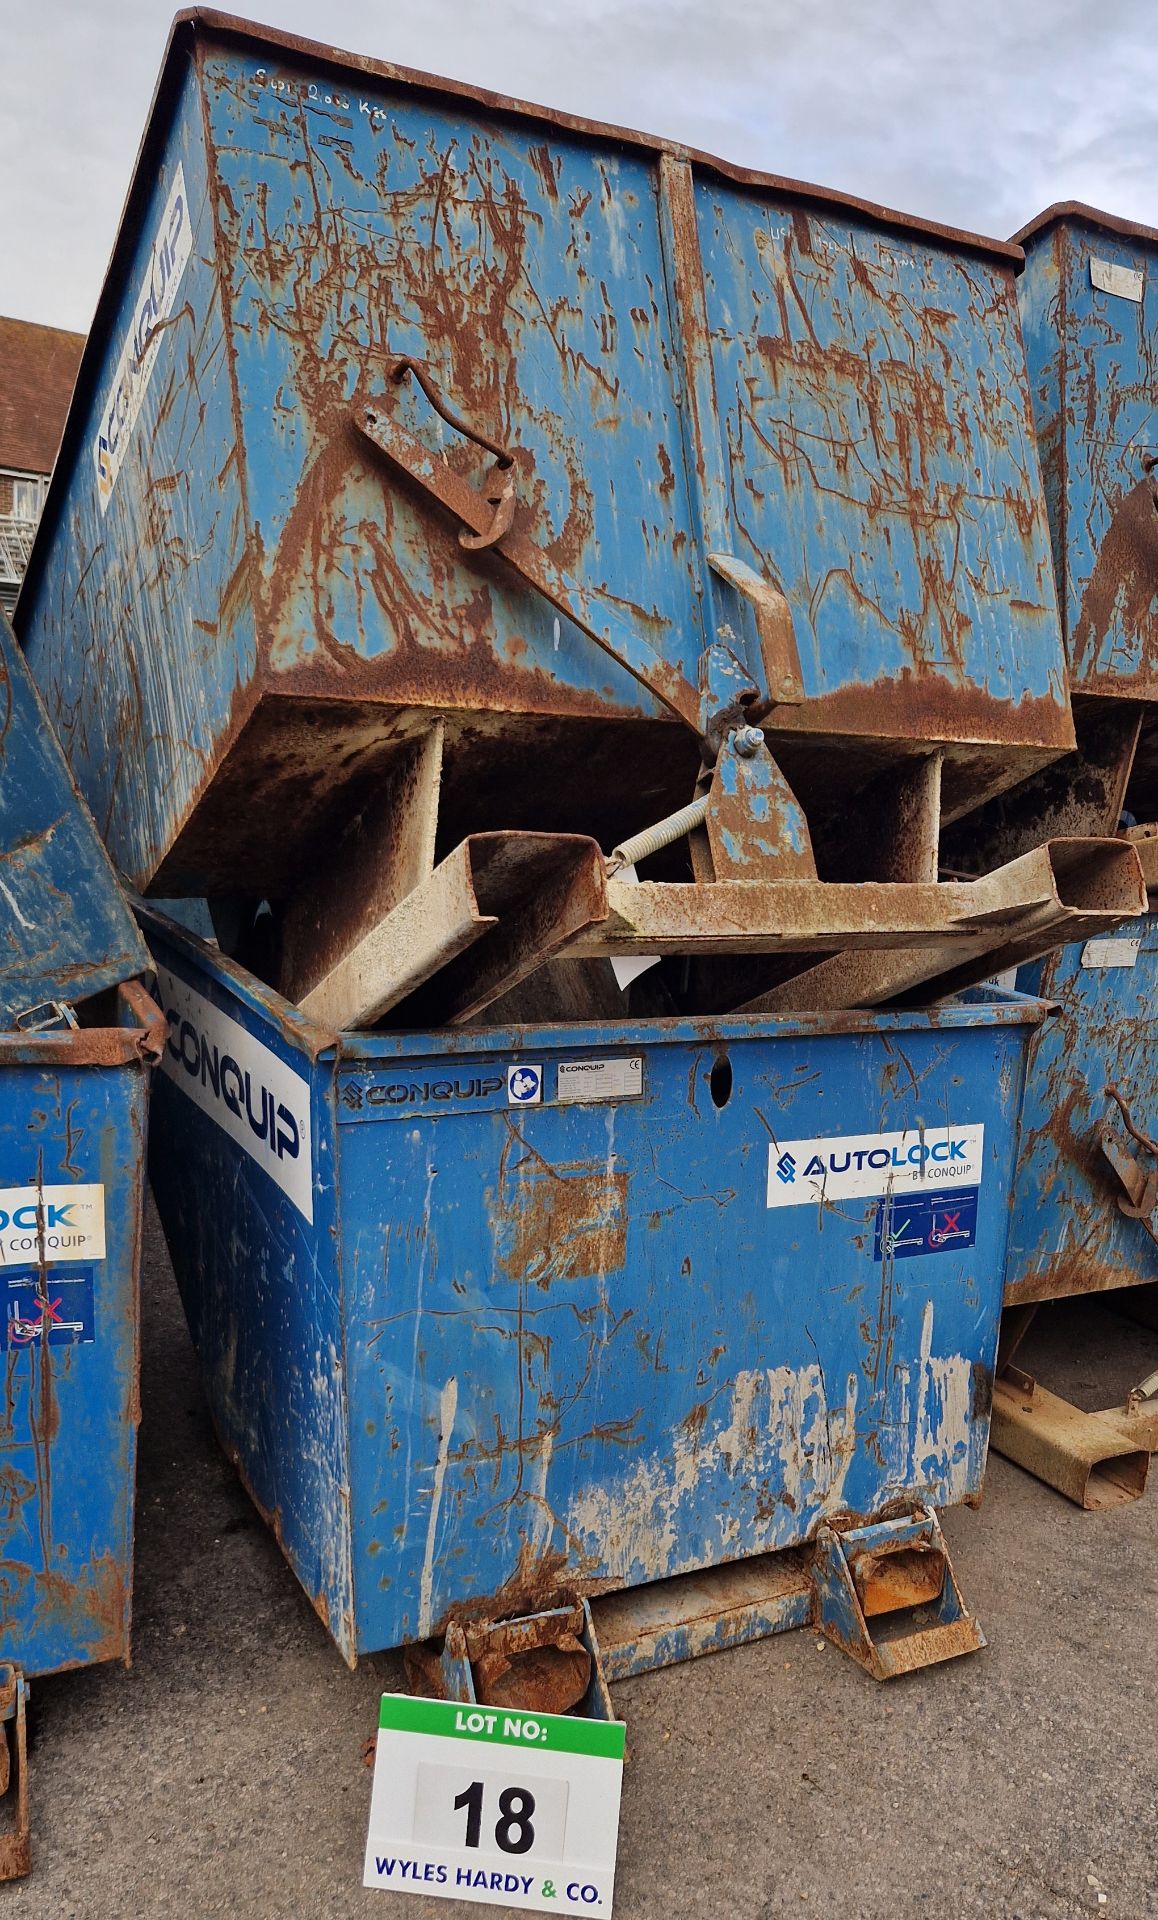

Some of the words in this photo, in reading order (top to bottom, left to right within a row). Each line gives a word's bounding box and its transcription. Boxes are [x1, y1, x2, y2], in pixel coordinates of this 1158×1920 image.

[166, 1008, 300, 1161] CONQUIP
[565, 1063, 605, 1073] CONQUIP
[365, 1077, 503, 1105] CONQUIP
[802, 1139, 969, 1177] AUTOLOCK
[455, 1711, 498, 1734] LOT
[503, 1716, 548, 1742] NO:
[453, 1781, 536, 1855] 18
[375, 1856, 448, 1884] WYLES
[456, 1867, 535, 1895] HARDY
[541, 1879, 558, 1899] &
[566, 1882, 603, 1905] CO.
